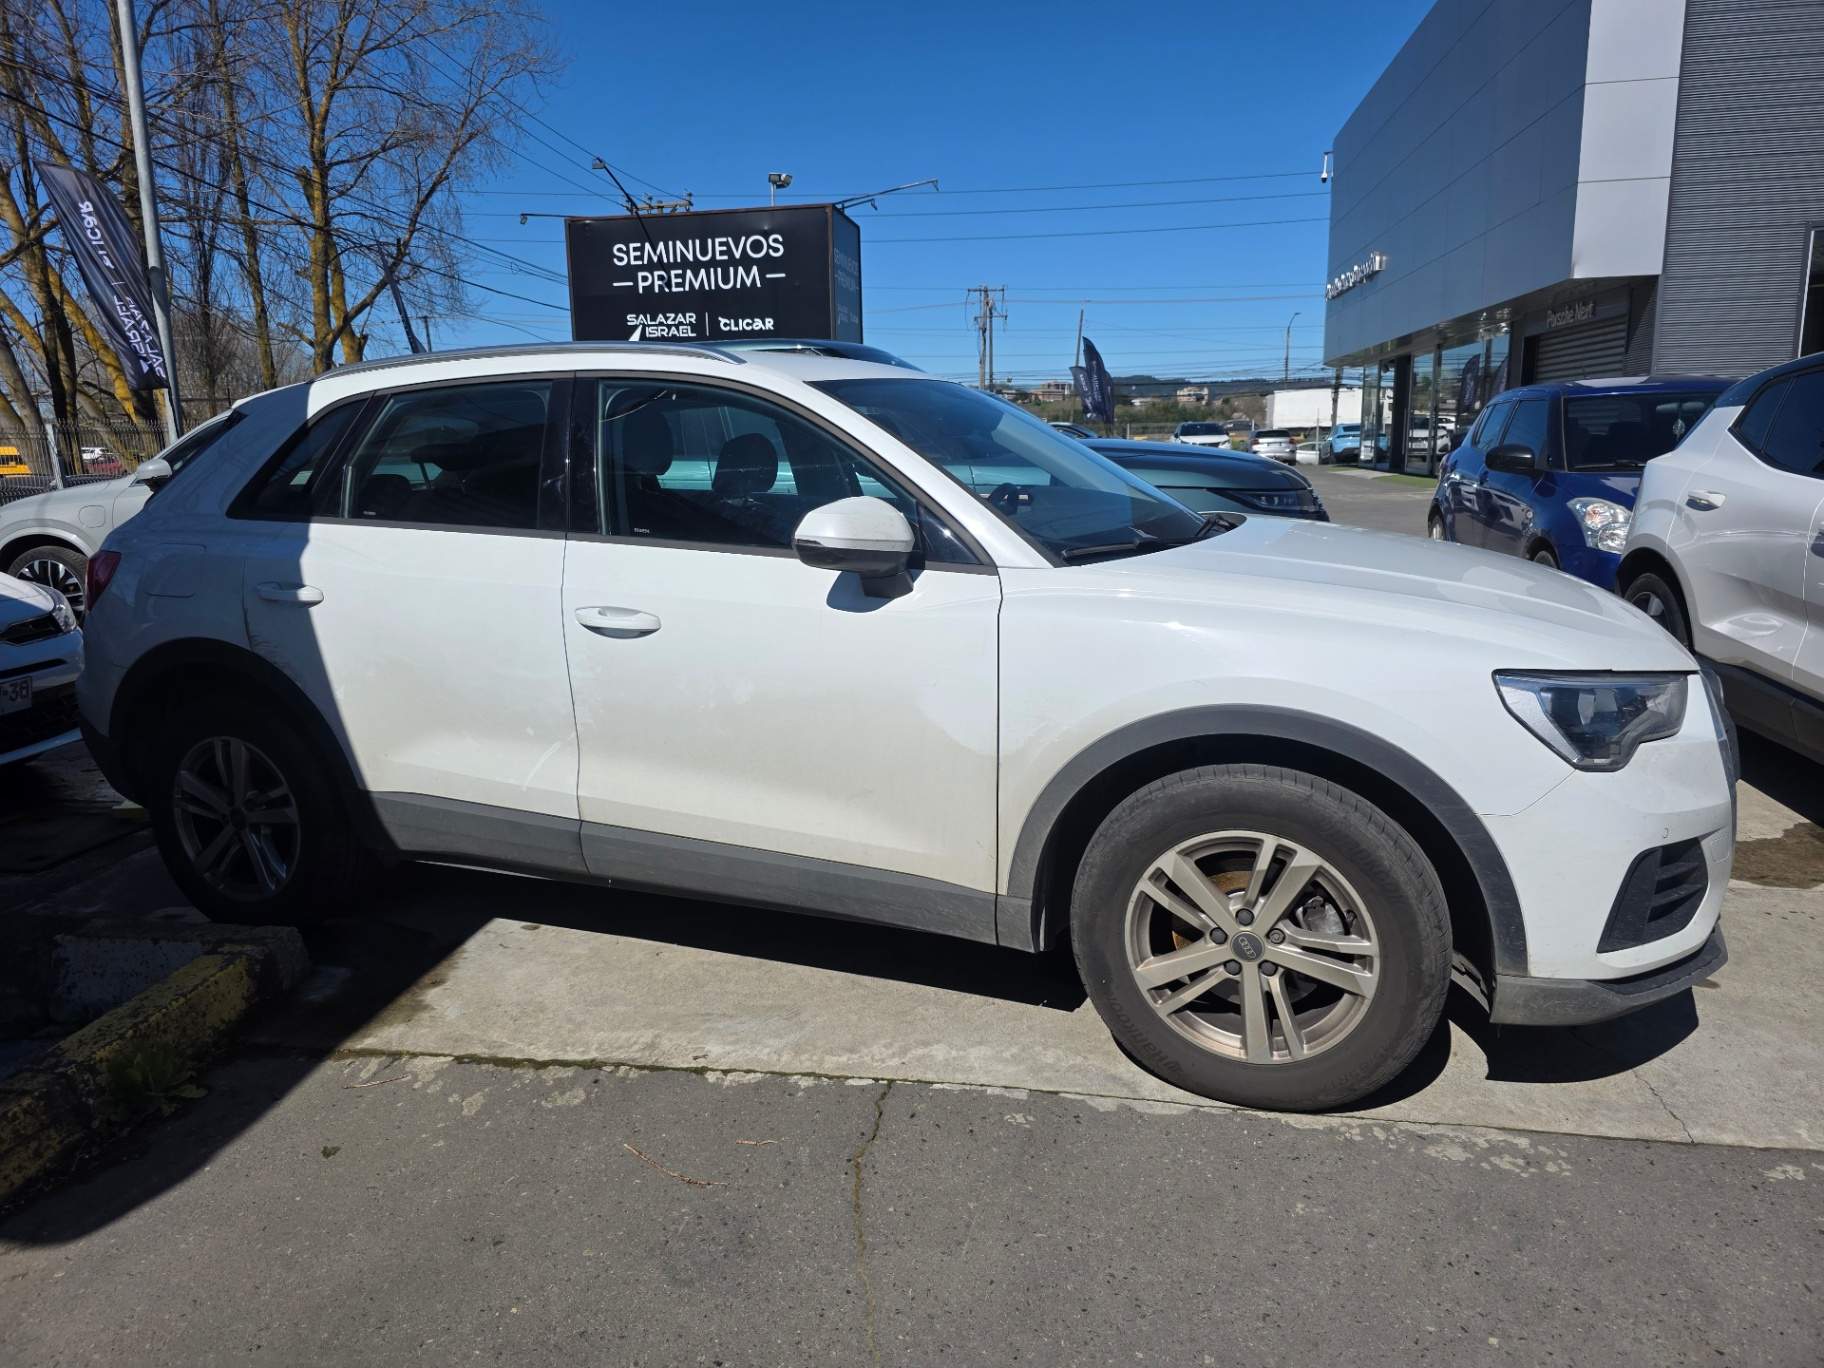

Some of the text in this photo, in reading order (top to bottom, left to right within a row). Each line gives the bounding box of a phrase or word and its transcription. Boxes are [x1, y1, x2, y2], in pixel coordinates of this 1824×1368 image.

[613, 234, 784, 266] SEMINUEVOS
[637, 265, 761, 294] PREMIUM
[626, 312, 697, 326] SALAZAR
[645, 325, 697, 338] ISRAEL
